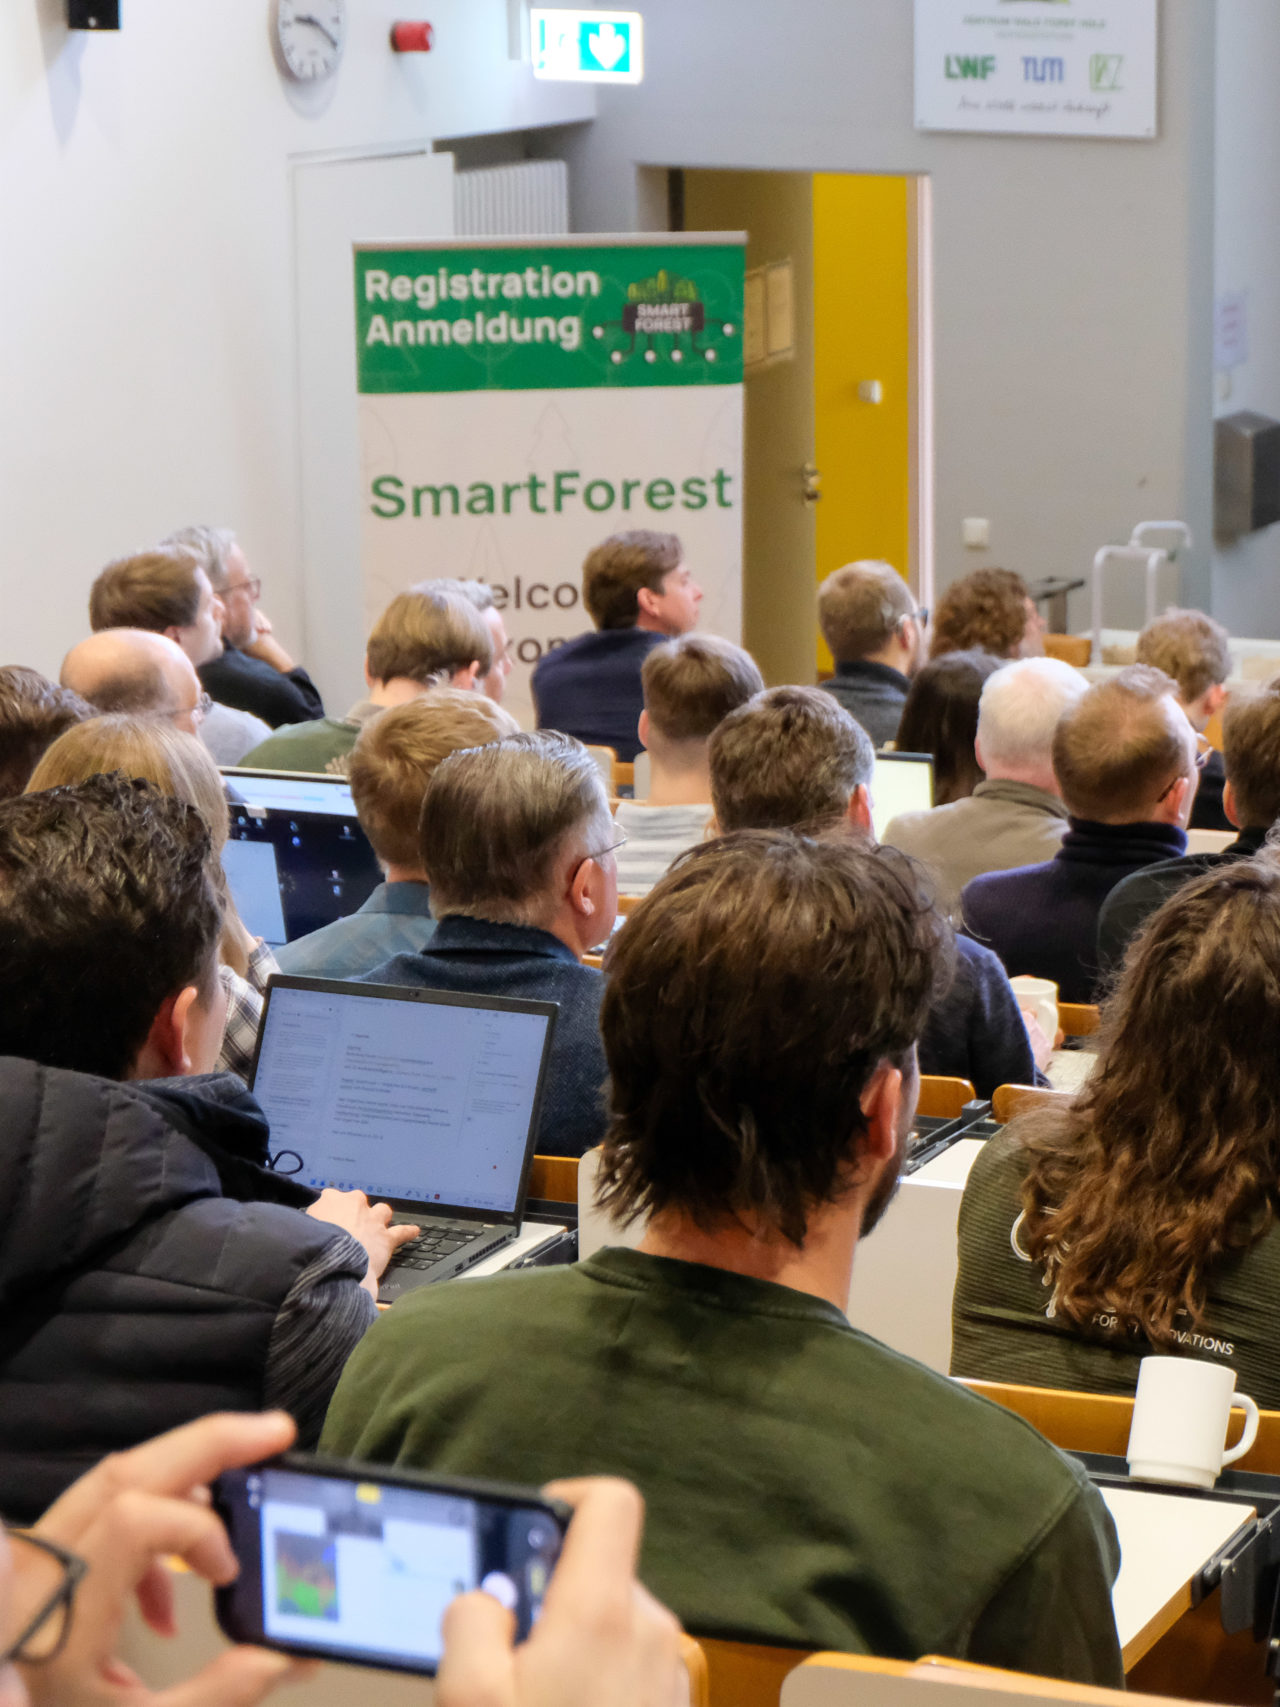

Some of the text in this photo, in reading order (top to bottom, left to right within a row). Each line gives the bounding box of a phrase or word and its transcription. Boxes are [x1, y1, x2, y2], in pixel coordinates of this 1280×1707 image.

[944, 54, 996, 80] LWF
[1021, 56, 1065, 82] TUM
[364, 266, 599, 310] Registration
[637, 303, 690, 316] SMART
[366, 312, 581, 351] Anmeldung
[634, 316, 693, 332] FOREST
[370, 469, 733, 518] SmartForest
